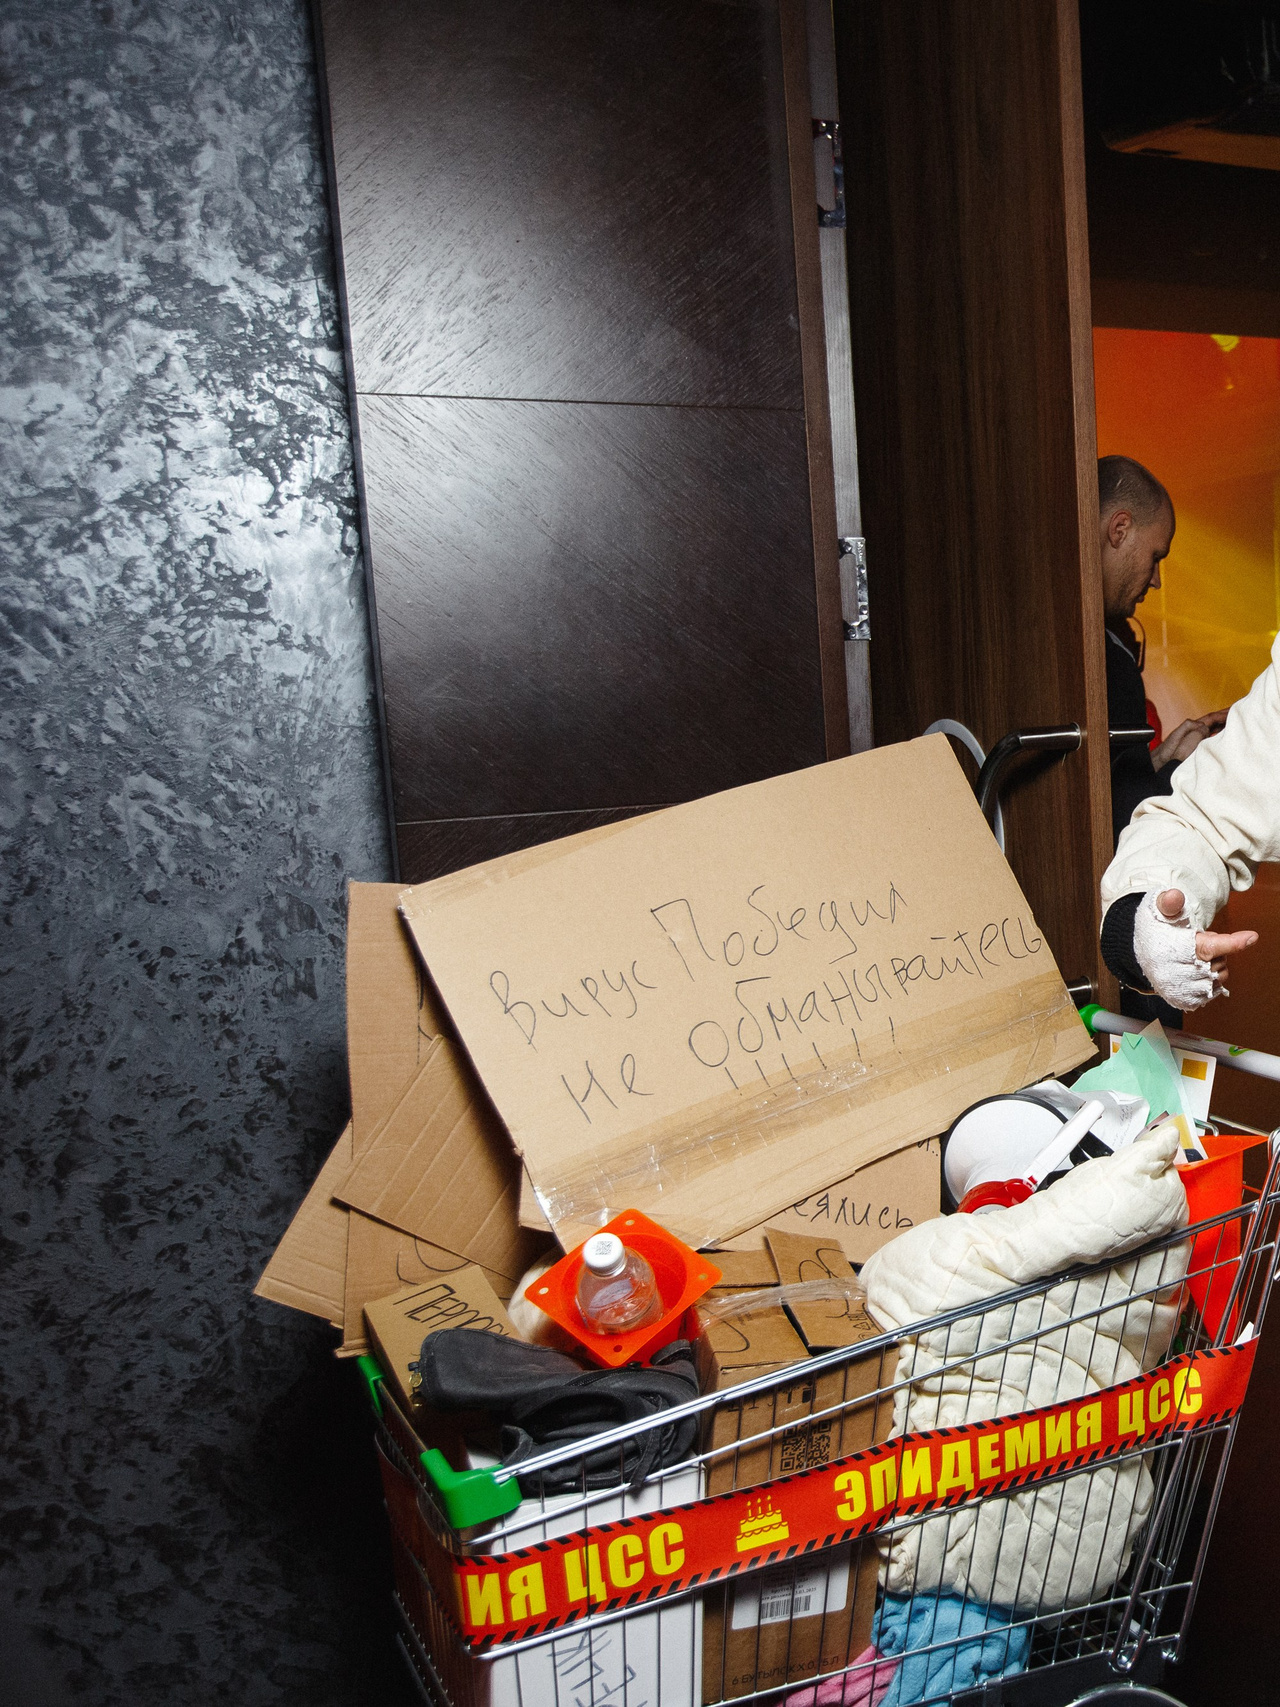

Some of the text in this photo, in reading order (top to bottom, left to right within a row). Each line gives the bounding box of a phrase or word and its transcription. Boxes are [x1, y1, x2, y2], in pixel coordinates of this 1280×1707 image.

[651, 881, 909, 983] Победил
[782, 1192, 914, 1231] еялись
[833, 1366, 1203, 1521] ЭПИДЕМИЯ ЦСС
[454, 1561, 548, 1627] ИЯ
[563, 1522, 686, 1603] ЦСС
[731, 1676, 739, 1685] 6
